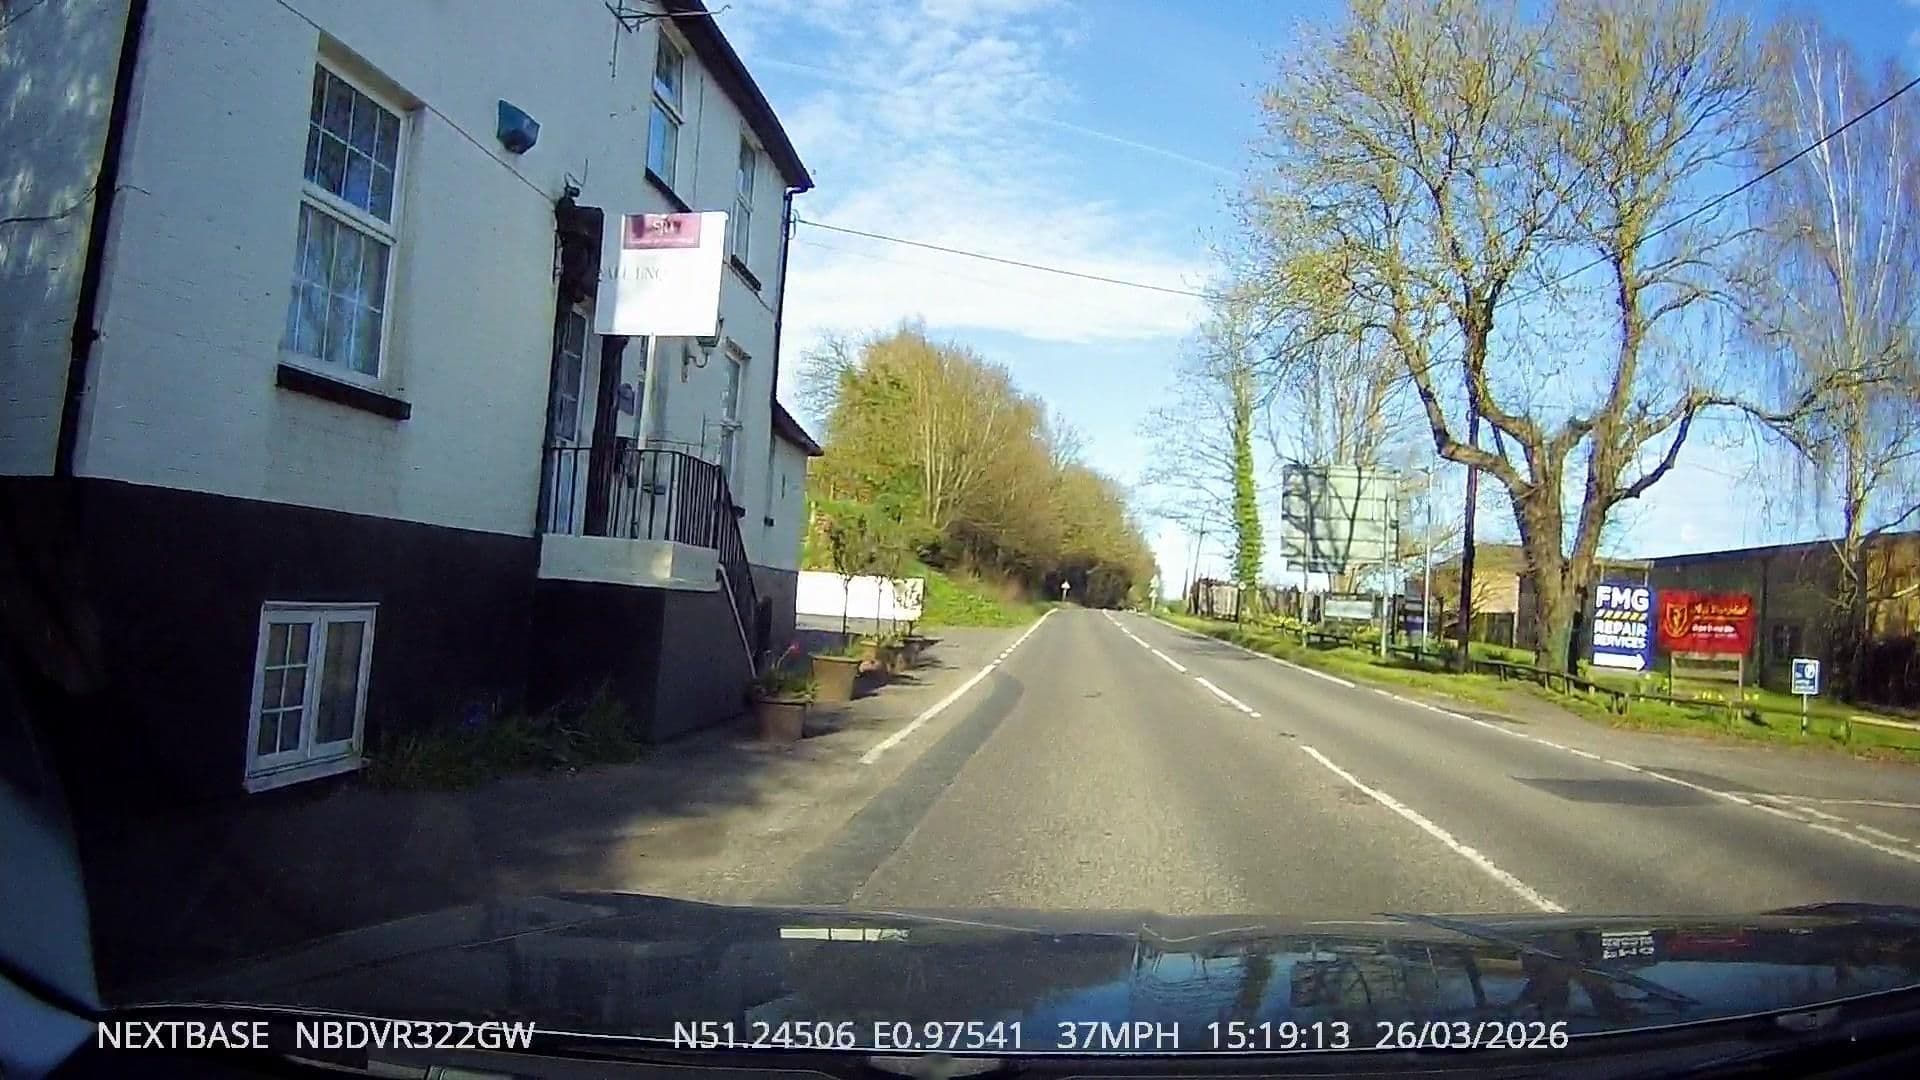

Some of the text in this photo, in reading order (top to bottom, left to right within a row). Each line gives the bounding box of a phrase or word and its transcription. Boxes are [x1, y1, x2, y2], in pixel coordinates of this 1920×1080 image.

[1595, 585, 1649, 612] FMG
[1594, 619, 1648, 637] REPAIR
[1593, 633, 1647, 649] SERVICES
